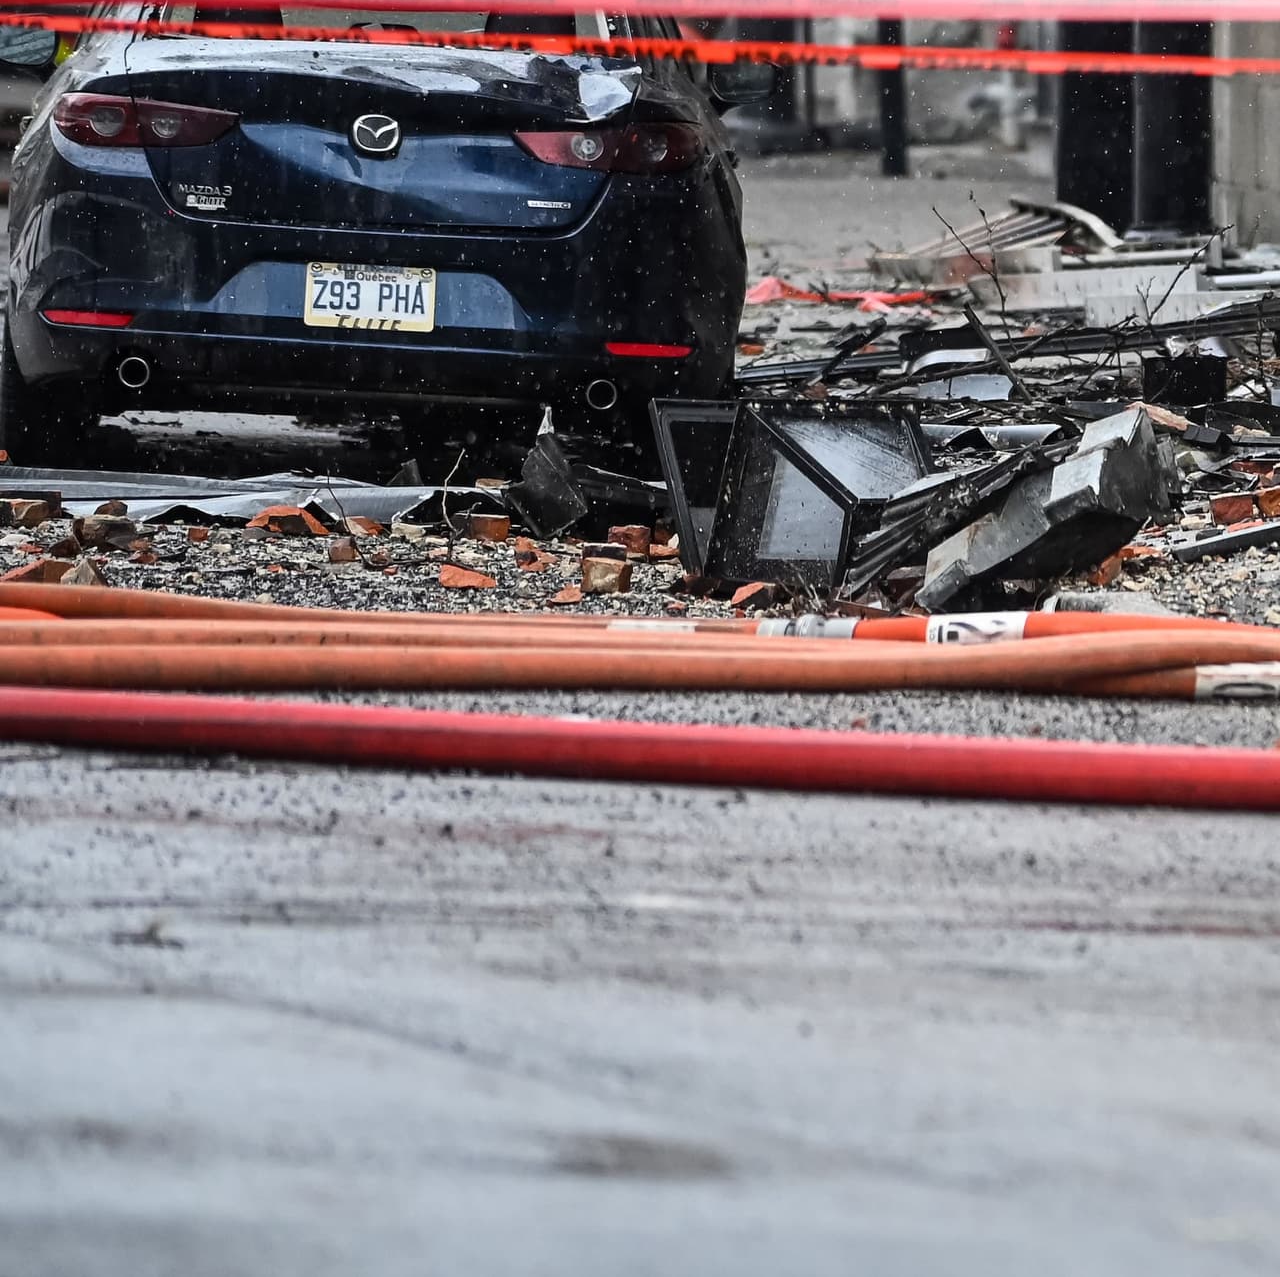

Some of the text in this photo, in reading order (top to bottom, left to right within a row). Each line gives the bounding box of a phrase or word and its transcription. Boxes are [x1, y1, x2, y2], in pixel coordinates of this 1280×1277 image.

[356, 271, 398, 283] Québec
[312, 279, 425, 315] Z93 PHA
